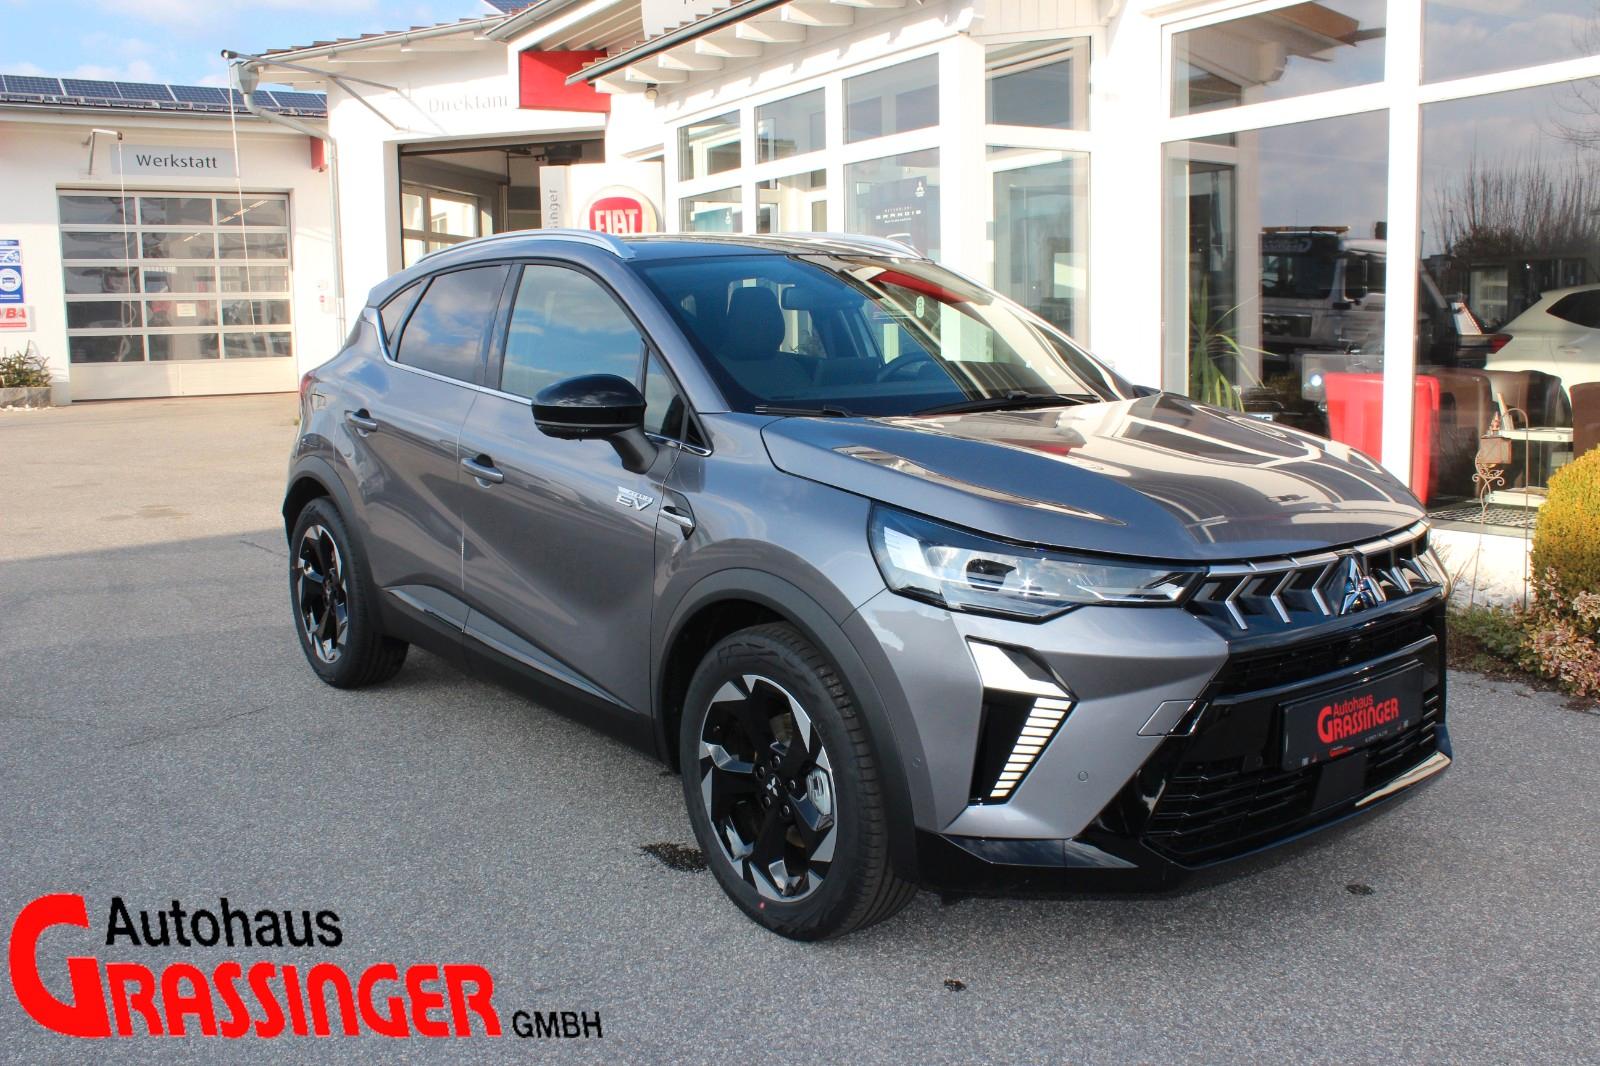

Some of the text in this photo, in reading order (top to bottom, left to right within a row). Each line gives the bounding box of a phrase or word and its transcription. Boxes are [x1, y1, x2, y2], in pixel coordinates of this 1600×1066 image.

[135, 153, 218, 169] Werkstatt
[594, 208, 639, 234] FIAT
[1333, 694, 1374, 717] Autohaus
[1317, 697, 1399, 744] GRASSINGER
